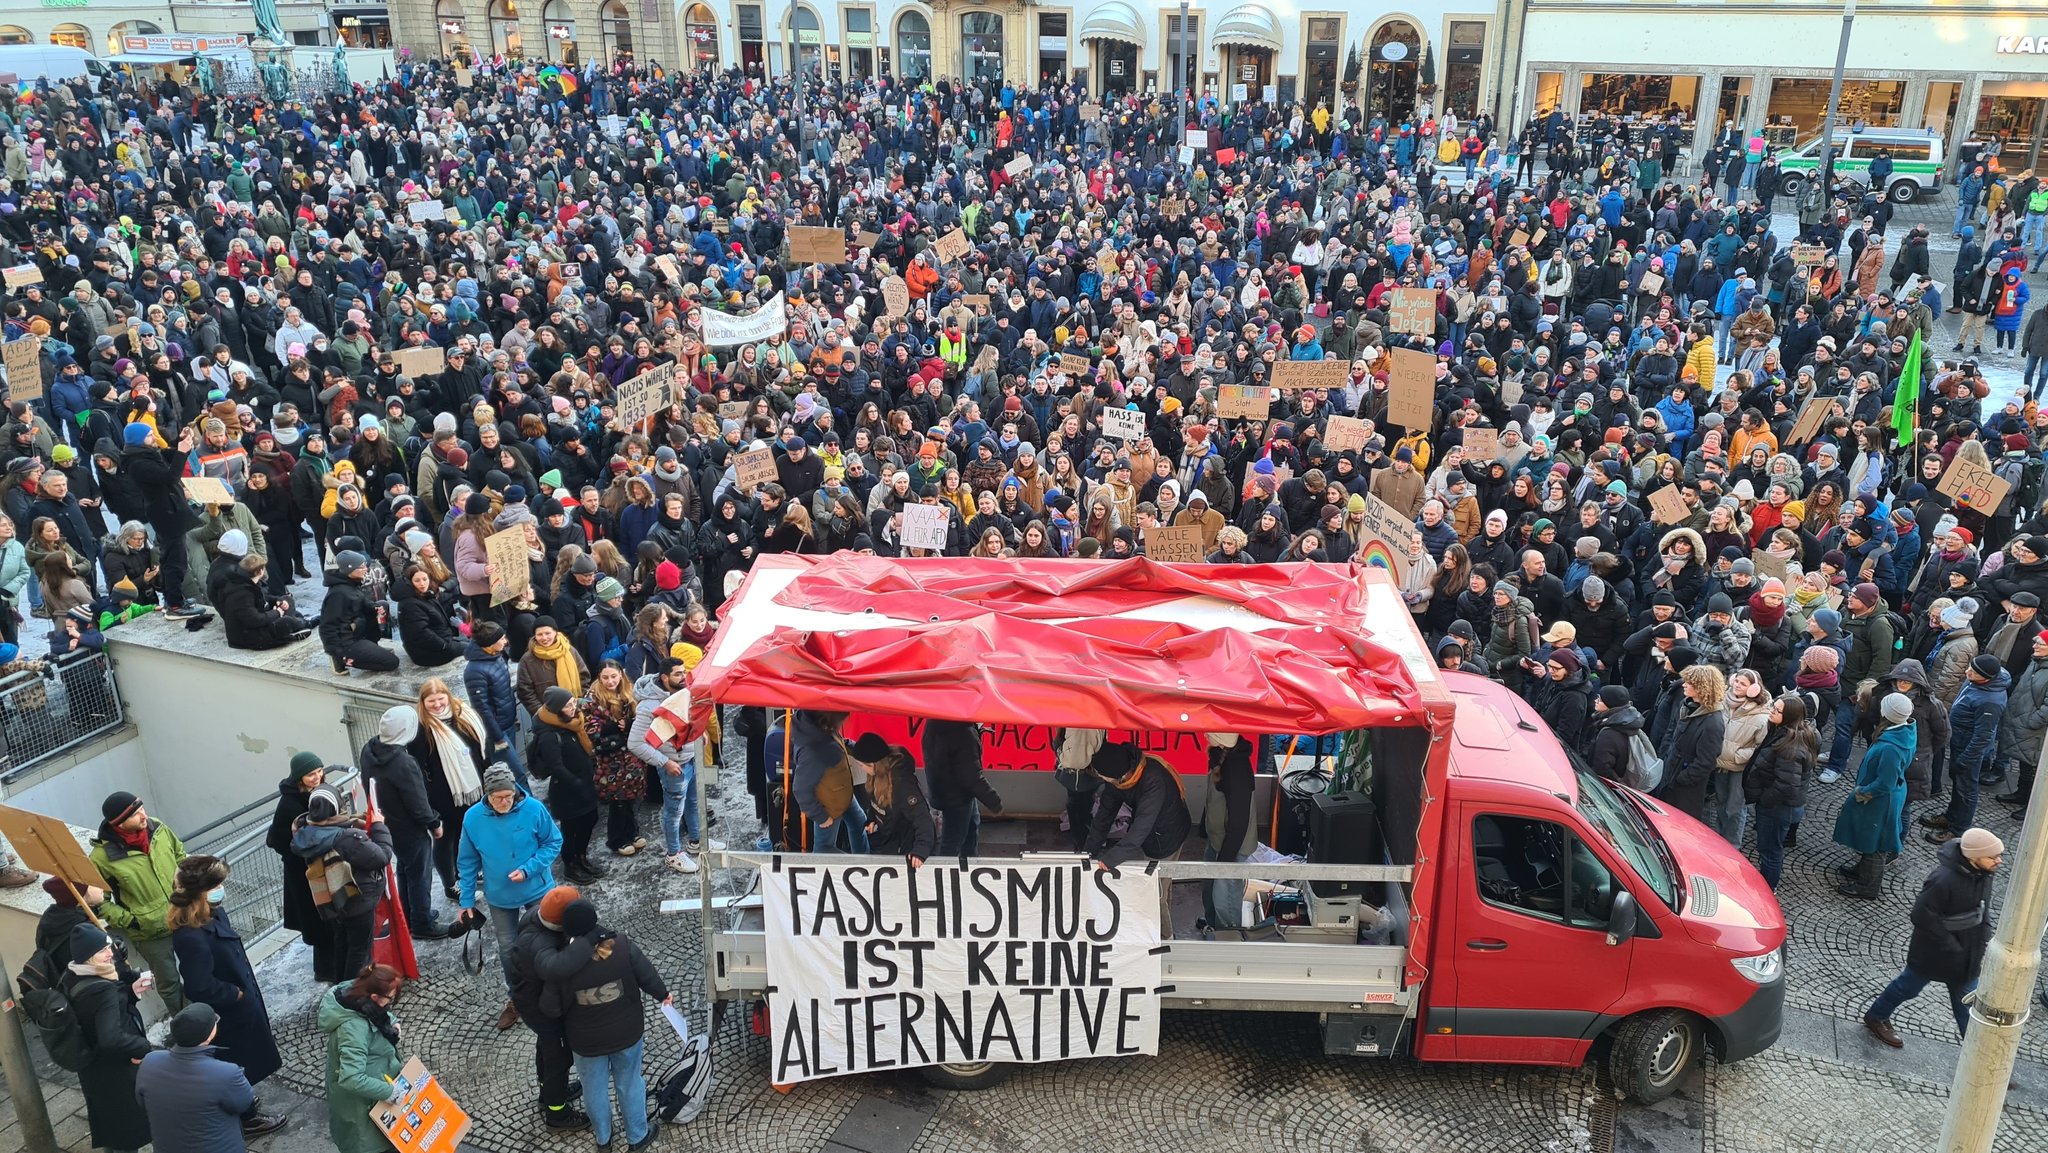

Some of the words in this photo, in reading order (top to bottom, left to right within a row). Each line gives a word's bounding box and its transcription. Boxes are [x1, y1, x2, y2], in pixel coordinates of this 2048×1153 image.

[1275, 362, 1288, 370] DIE
[1307, 362, 1318, 370] IST
[619, 377, 644, 400] NAZIS
[1402, 389, 1418, 399] IST
[624, 397, 636, 410] IST
[1393, 400, 1422, 414] JETZT
[622, 404, 646, 427] 1933
[1109, 409, 1132, 421] HASS
[1135, 415, 1144, 424] ist
[1119, 421, 1135, 430] KEINE
[1329, 419, 1345, 432] Nie
[1956, 462, 1994, 494] EKEL
[1156, 530, 1189, 541] ALLE
[1150, 543, 1197, 555] HASSEN
[787, 863, 1122, 942] FASCHISMUS
[843, 938, 936, 990] IST
[966, 941, 1114, 987] KEINE
[1366, 993, 1393, 1001] SCHUTZ
[778, 987, 1146, 1082] ALTERNATIVE
